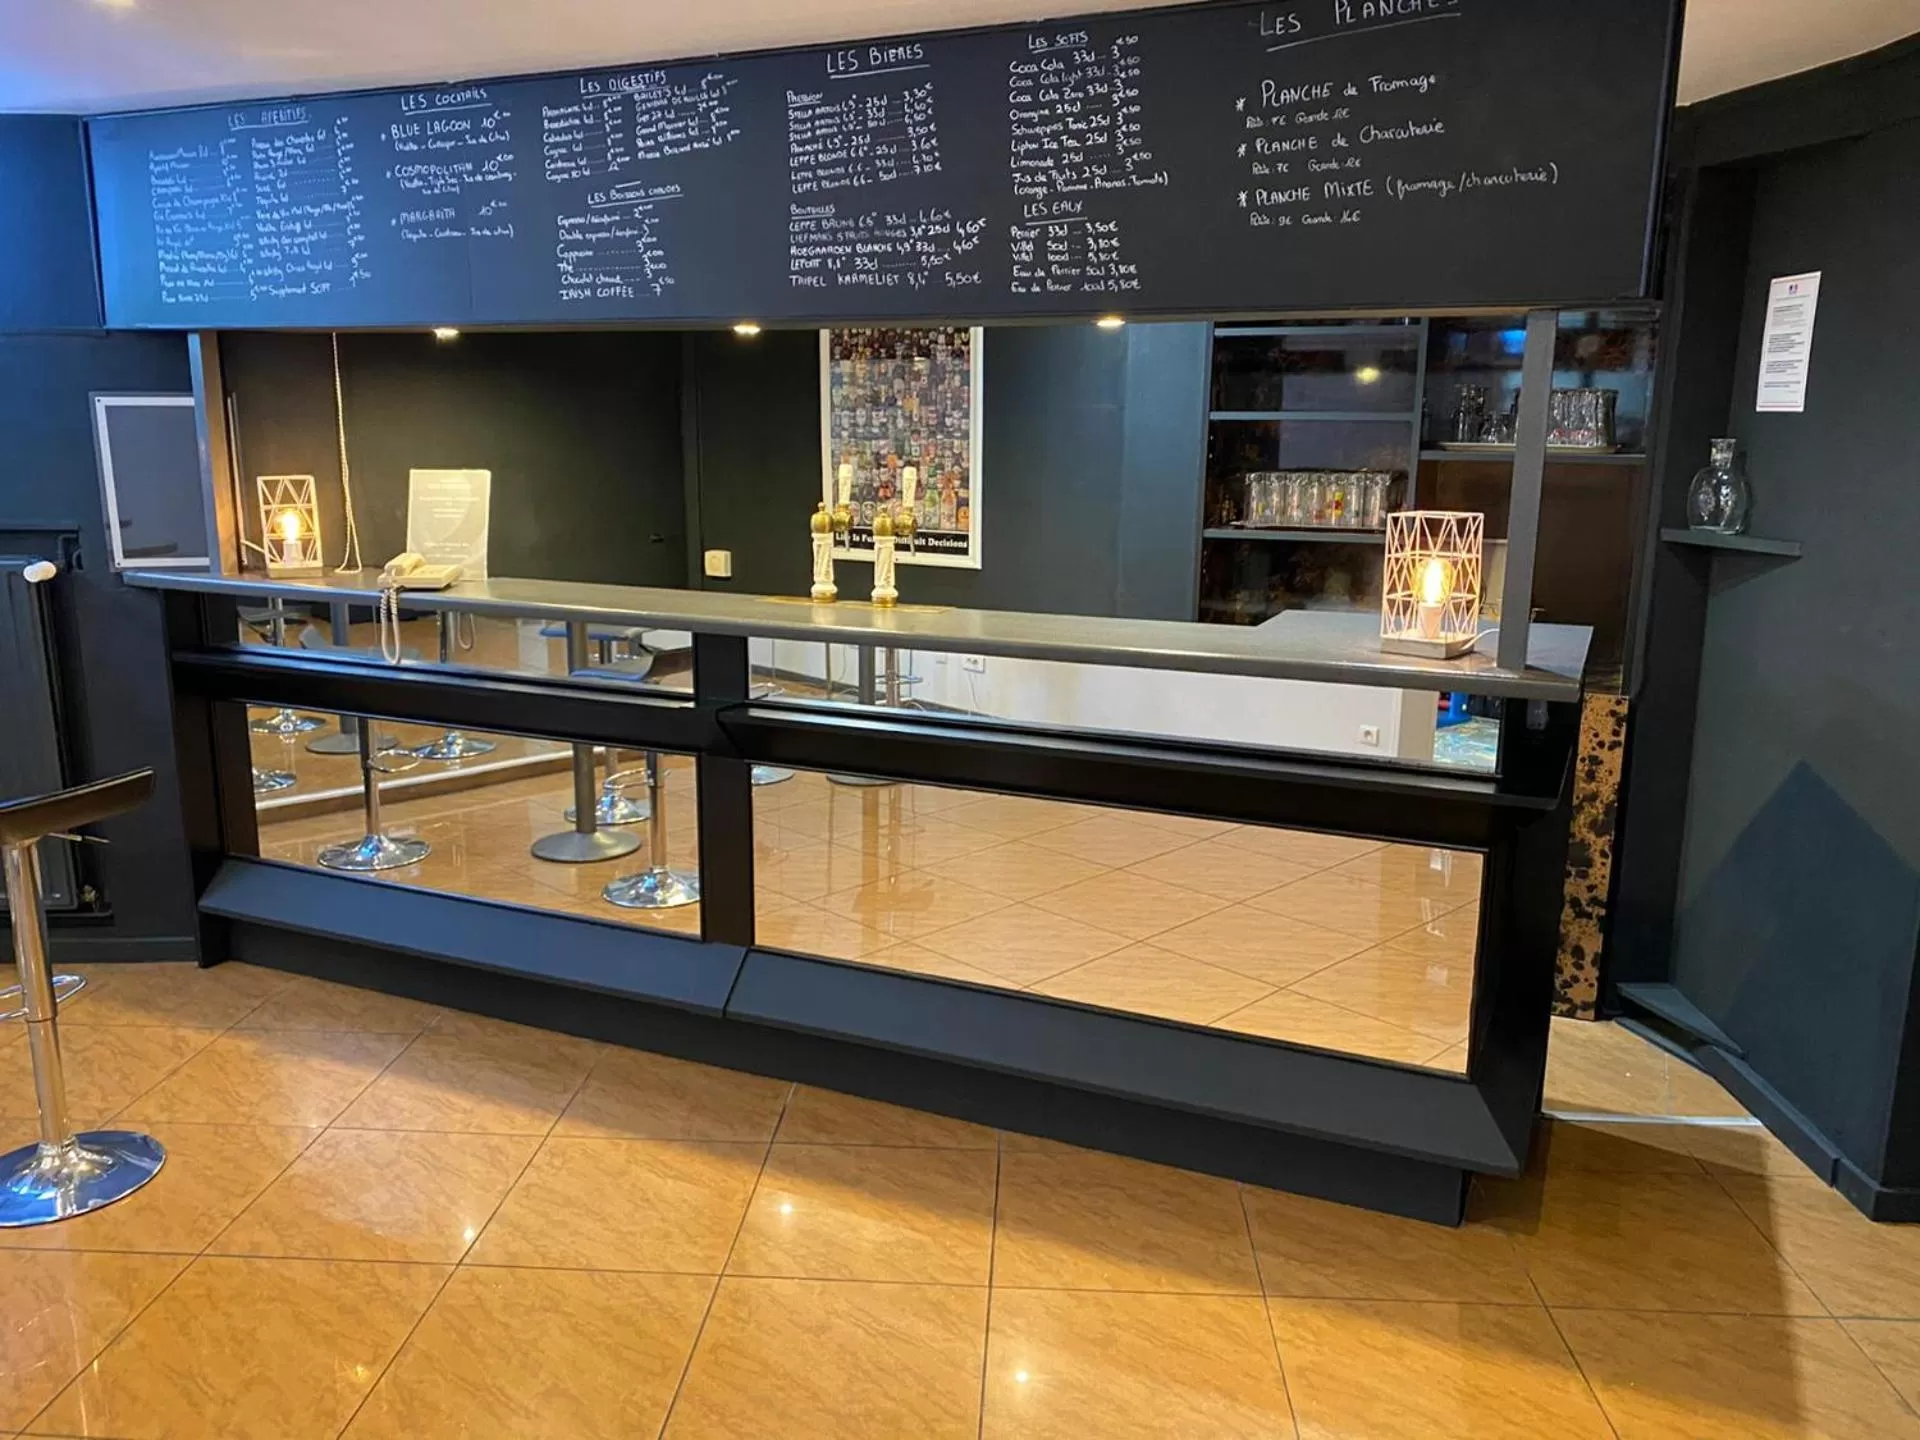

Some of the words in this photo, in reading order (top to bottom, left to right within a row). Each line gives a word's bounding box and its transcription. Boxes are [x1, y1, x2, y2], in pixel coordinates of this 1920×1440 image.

[1260, 11, 1301, 36] LES
[1055, 30, 1089, 47] SOFTS
[826, 49, 860, 73] LES
[1009, 60, 1039, 74] Coca
[1041, 58, 1065, 71] Cola
[580, 77, 601, 95] LES
[608, 69, 668, 92] DIGESTIFS
[1009, 76, 1034, 88] Coca
[1040, 72, 1060, 84] Cola
[1009, 90, 1033, 103] Coca
[1038, 88, 1060, 102] Cola
[1261, 79, 1334, 108] PLANCHE
[1343, 82, 1358, 97] de
[400, 93, 428, 112] LES
[390, 122, 422, 140] BLUE
[426, 119, 472, 136] LAGOON
[1065, 116, 1089, 130] Tonic
[1059, 134, 1082, 148] Tea
[1255, 137, 1318, 155] PLANCHE
[1331, 131, 1349, 147] de
[1359, 117, 1445, 144] Charcuterie
[394, 160, 474, 178] COSMOPOLITAN
[587, 191, 607, 206] LES
[1255, 187, 1311, 206] PLANCHE
[1023, 203, 1048, 219] LES
[1051, 199, 1083, 216] EAUX
[788, 274, 828, 289] TRIPEL
[836, 272, 900, 289] KARMELIET
[596, 285, 636, 299] COFFEE
[927, 537, 967, 548] Decisions
